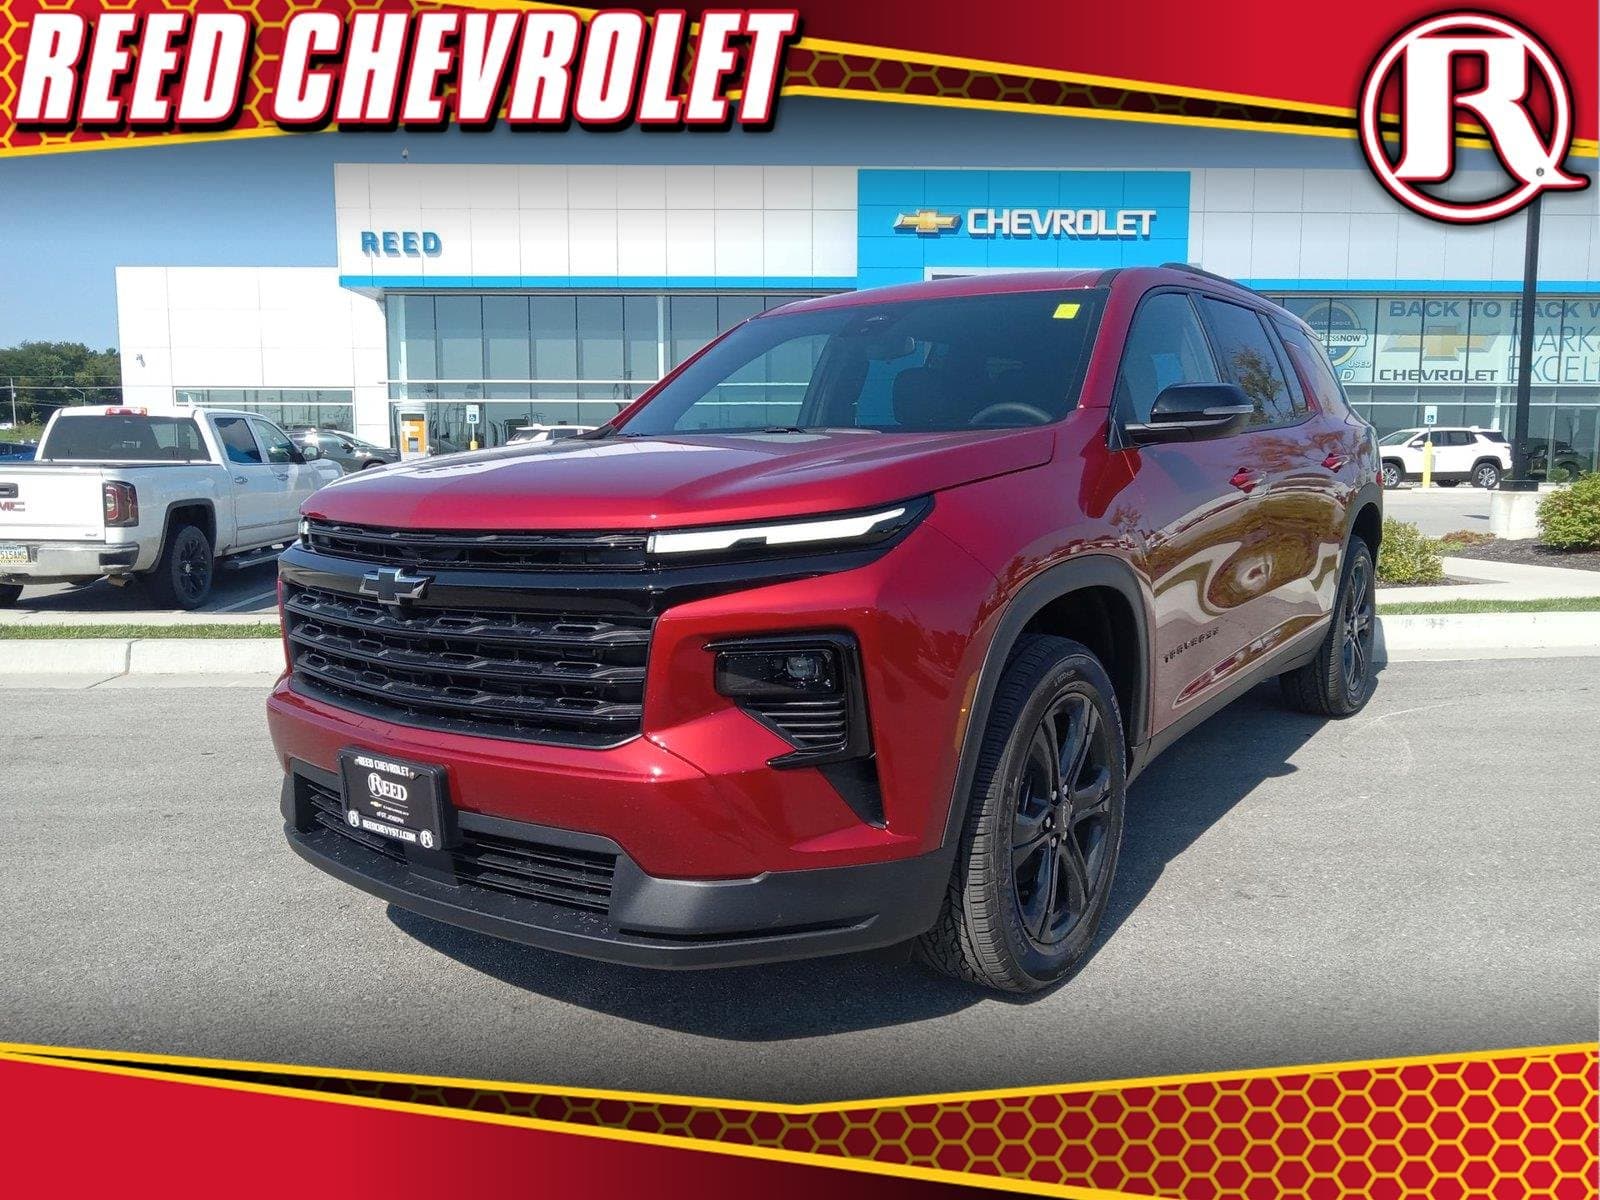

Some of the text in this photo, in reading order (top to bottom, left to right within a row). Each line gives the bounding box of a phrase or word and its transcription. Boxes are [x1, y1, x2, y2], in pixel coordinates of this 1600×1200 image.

[967, 208, 1157, 239] CHEVROLET
[361, 231, 442, 257] REED
[1389, 301, 1460, 317] BACK
[1471, 301, 1502, 317] TO
[1348, 360, 1372, 368] USED
[1379, 368, 1499, 382] CHEVROLET
[374, 760, 409, 776] CHEVROLET
[368, 772, 407, 801] REED
